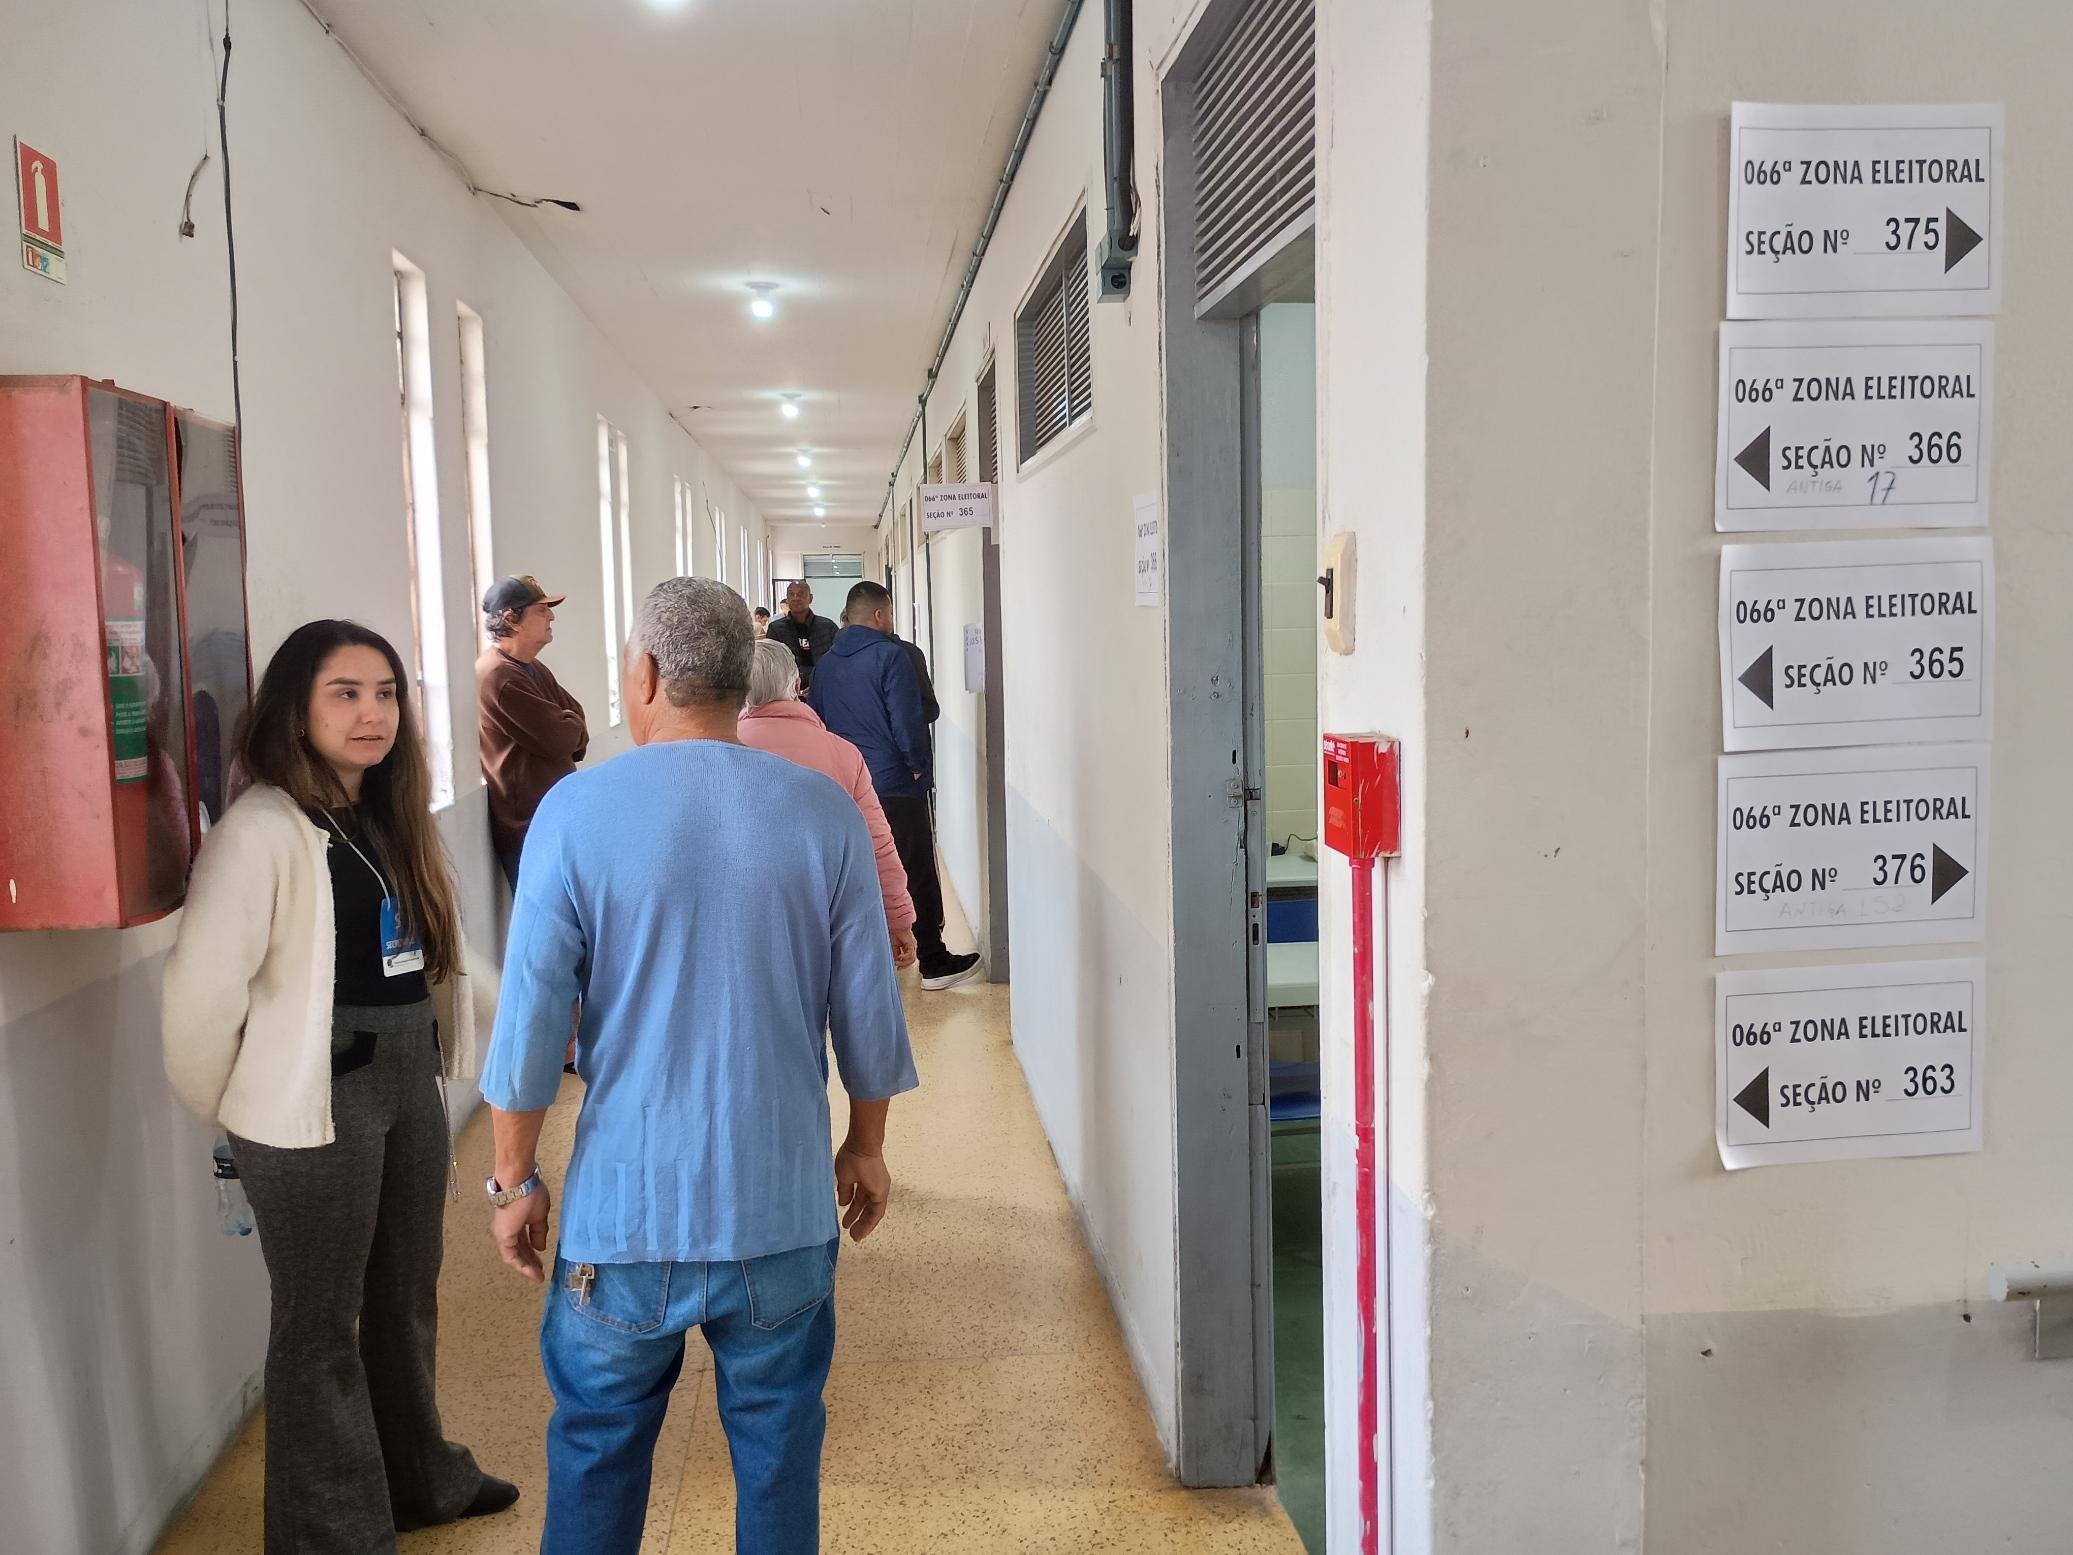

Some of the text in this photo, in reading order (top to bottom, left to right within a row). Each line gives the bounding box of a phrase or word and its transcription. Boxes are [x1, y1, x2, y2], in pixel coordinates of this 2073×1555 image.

[1744, 158, 1985, 186] 066ª ZONA ELEITORAL
[1745, 217, 1940, 264] SEÇÃO Nº 375
[1735, 374, 1976, 404] 066ª ZONA ELEITORAL
[1781, 430, 1962, 478] SEÇÃO Nº 366
[940, 494, 957, 502] ZONA
[958, 492, 988, 501] ELEITORAL
[958, 506, 974, 517] 365
[1735, 590, 1978, 624] 066ª ZONA ELEITORAL
[1784, 646, 1965, 695] SEÇÃO Nº 365
[1732, 796, 1971, 831] 066ª ZONA ELEITORAL
[1734, 852, 1926, 902] SEÇÃO Nº 376
[1732, 1010, 1968, 1047] 066ª ZONA ELEITORAL
[1779, 1063, 1956, 1113] SEÇÃO Nº 363
